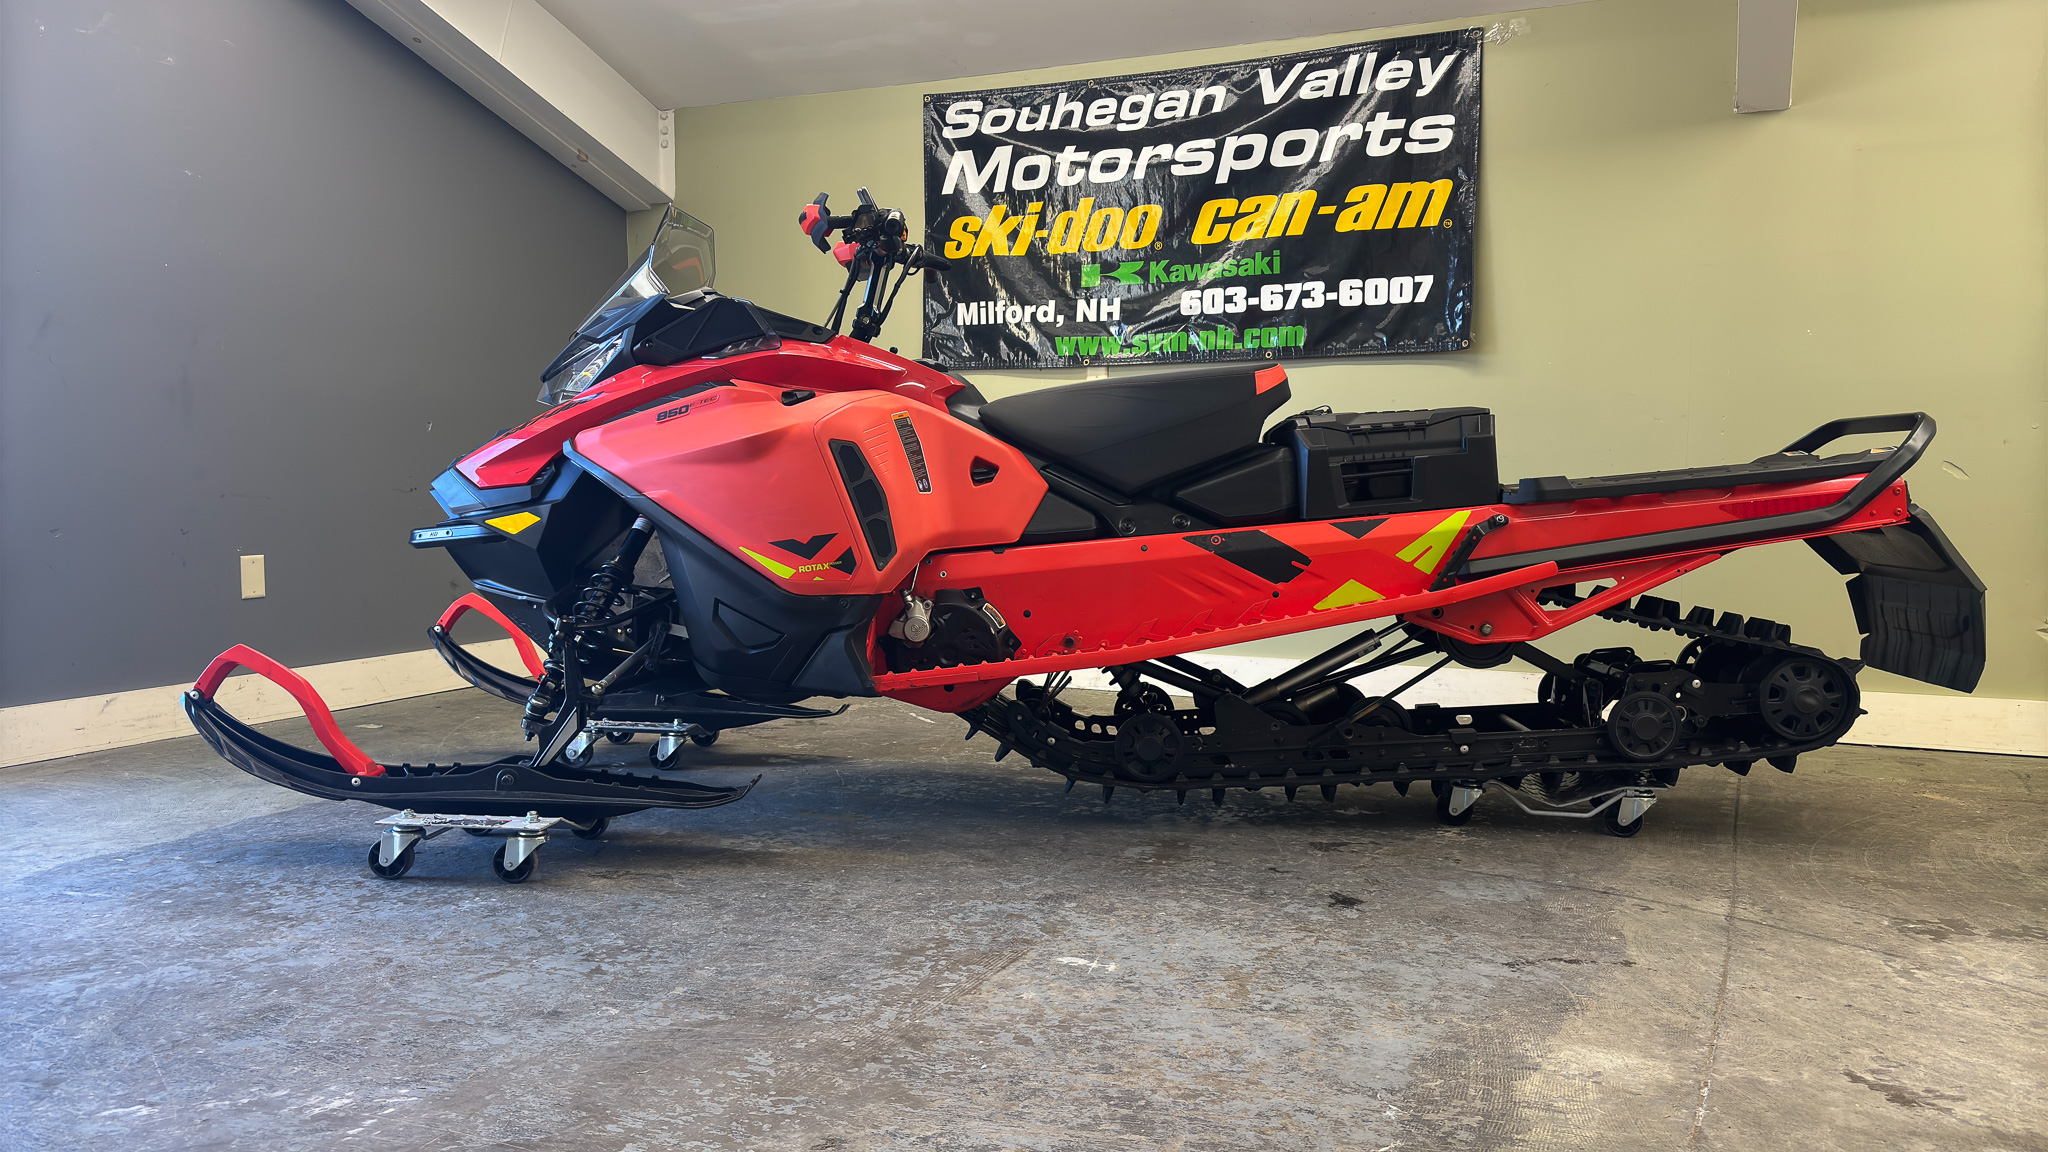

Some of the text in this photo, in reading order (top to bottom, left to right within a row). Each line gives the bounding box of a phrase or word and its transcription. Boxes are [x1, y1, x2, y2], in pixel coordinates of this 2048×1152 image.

[942, 52, 1459, 139] Souhegan Valley
[942, 112, 1456, 195] Motorsports
[944, 197, 1163, 260] ski-doo
[1191, 178, 1454, 245] can-am
[1150, 250, 1281, 284] Kawasaki
[957, 298, 1122, 328] Milford, NH
[1180, 275, 1435, 316] 603-673-6007
[1055, 325, 1305, 356] www.svm-nh.com
[656, 404, 690, 421] 850
[798, 562, 830, 573] ROTAX
